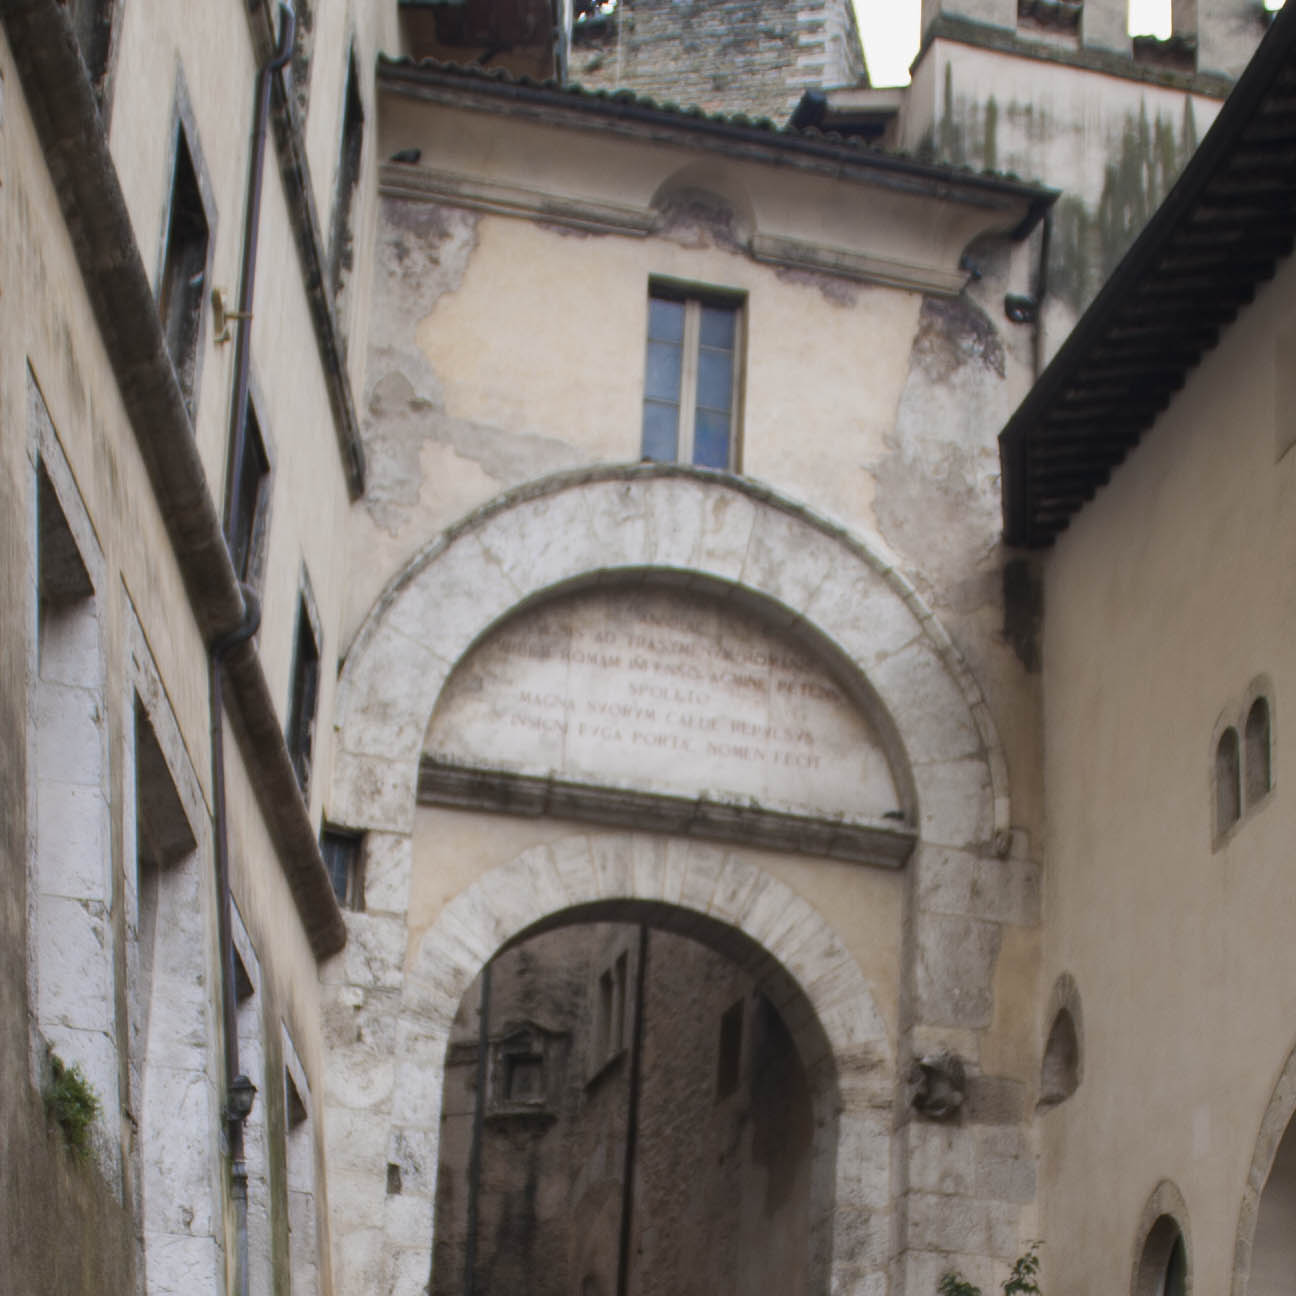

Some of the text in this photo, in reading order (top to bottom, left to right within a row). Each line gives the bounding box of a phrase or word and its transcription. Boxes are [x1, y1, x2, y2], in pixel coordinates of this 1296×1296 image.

[561, 647, 621, 669] ROMAM
[519, 690, 576, 713] MAGNA
[706, 741, 765, 761] NOMEN
